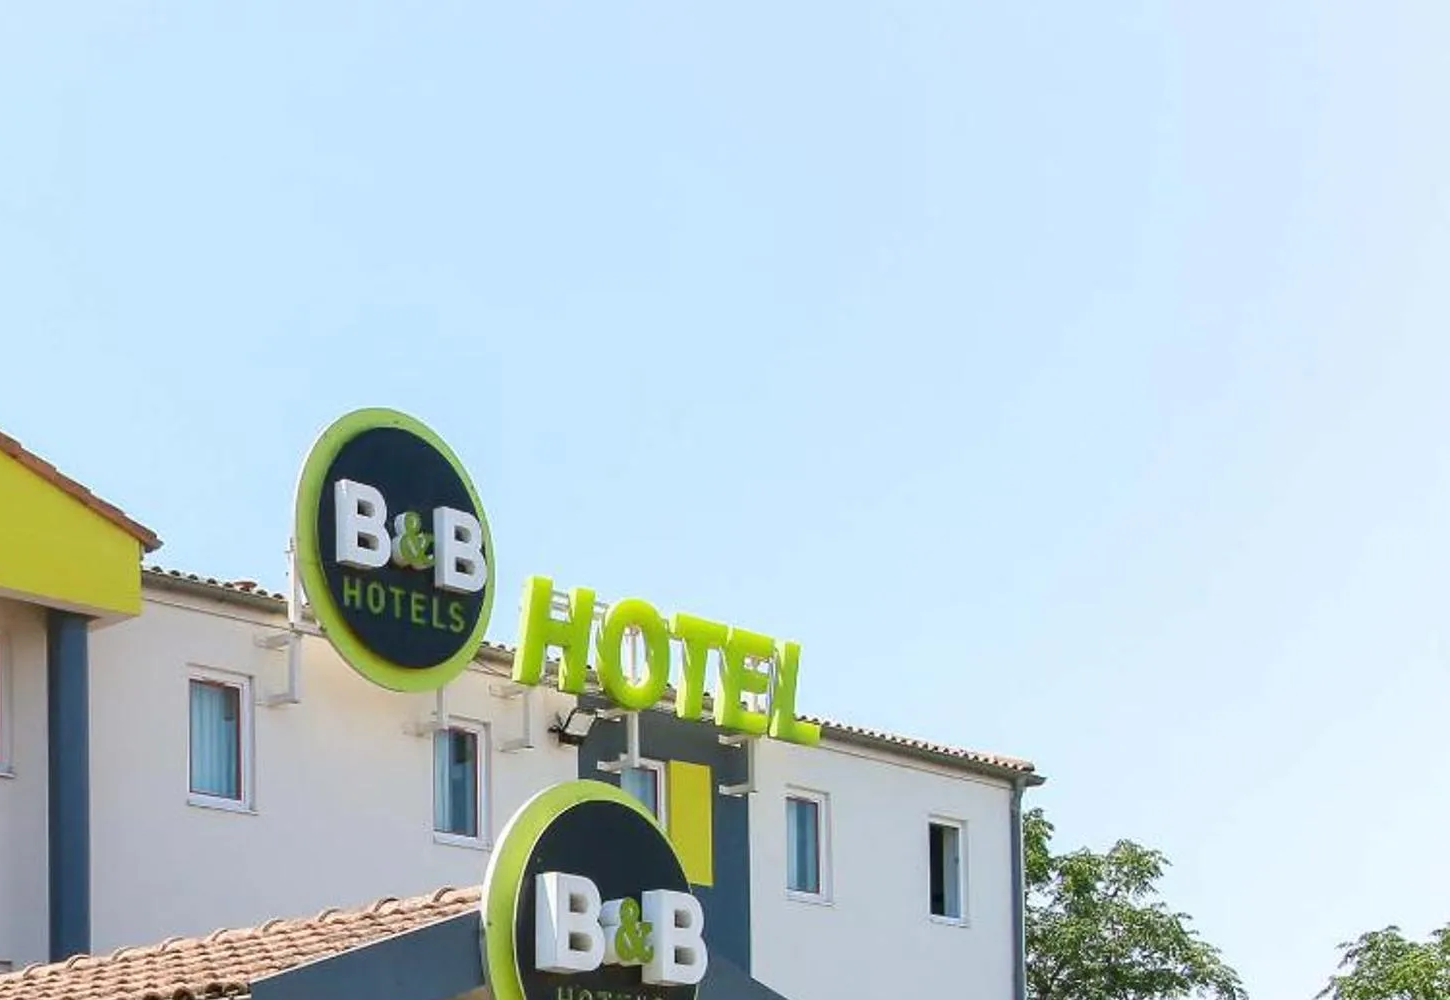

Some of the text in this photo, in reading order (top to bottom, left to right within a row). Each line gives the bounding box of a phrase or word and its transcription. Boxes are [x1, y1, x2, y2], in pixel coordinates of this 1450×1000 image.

[334, 477, 486, 594] B&B
[343, 575, 466, 633] HOTELS
[510, 574, 821, 746] HOTEL
[536, 871, 708, 986] B&B
